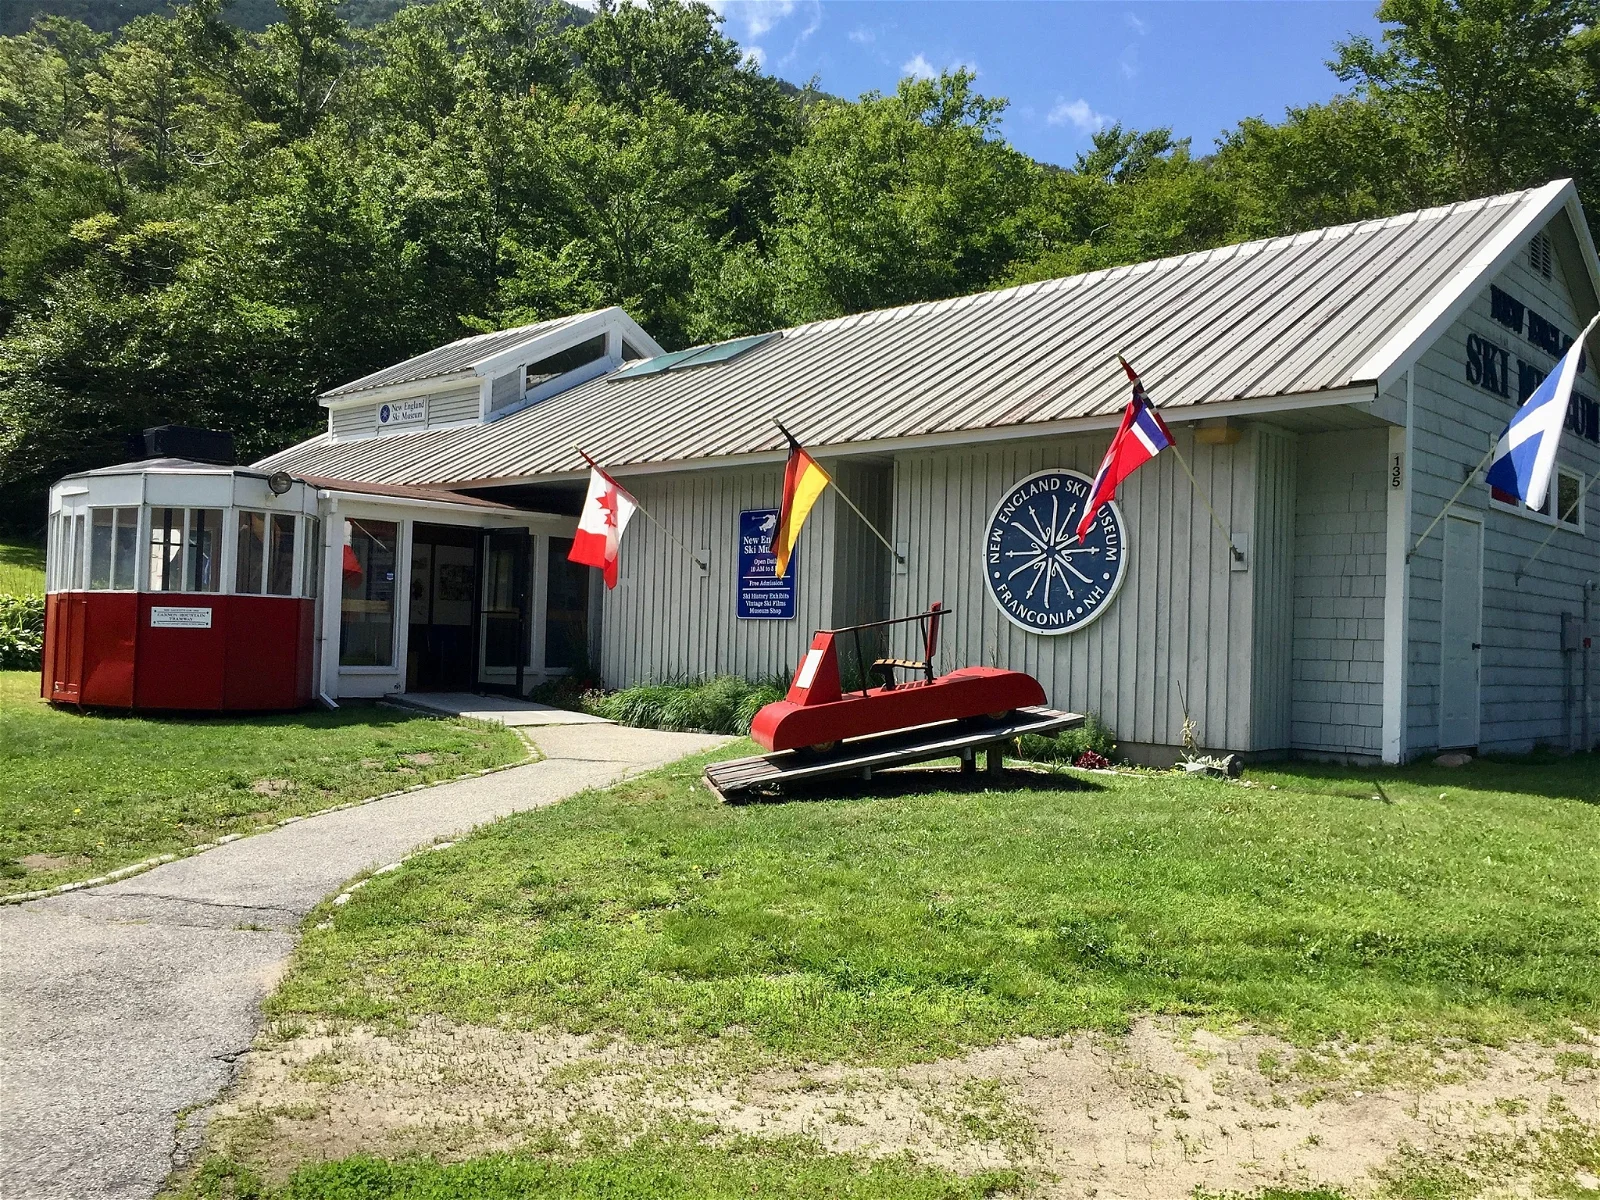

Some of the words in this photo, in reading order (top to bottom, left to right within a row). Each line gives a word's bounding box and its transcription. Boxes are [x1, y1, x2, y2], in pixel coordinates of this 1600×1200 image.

[1490, 283, 1525, 334] NEW
[1527, 310, 1587, 374] ENGL
[1466, 333, 1511, 399] SKI
[392, 403, 402, 412] New
[404, 399, 425, 412] England
[392, 413, 400, 421] Ski
[402, 412, 423, 420] Museum
[1392, 455, 1400, 487] 135
[989, 528, 1004, 564] NEW
[998, 478, 1060, 524] ENGLAND
[1065, 479, 1088, 498] SKI
[1096, 505, 1118, 561] USEUM
[743, 536, 759, 544] New
[744, 545, 757, 554] Ski
[770, 607, 782, 615] Shop
[996, 583, 1076, 625] FRANCONIA
[1083, 585, 1105, 610] NH
